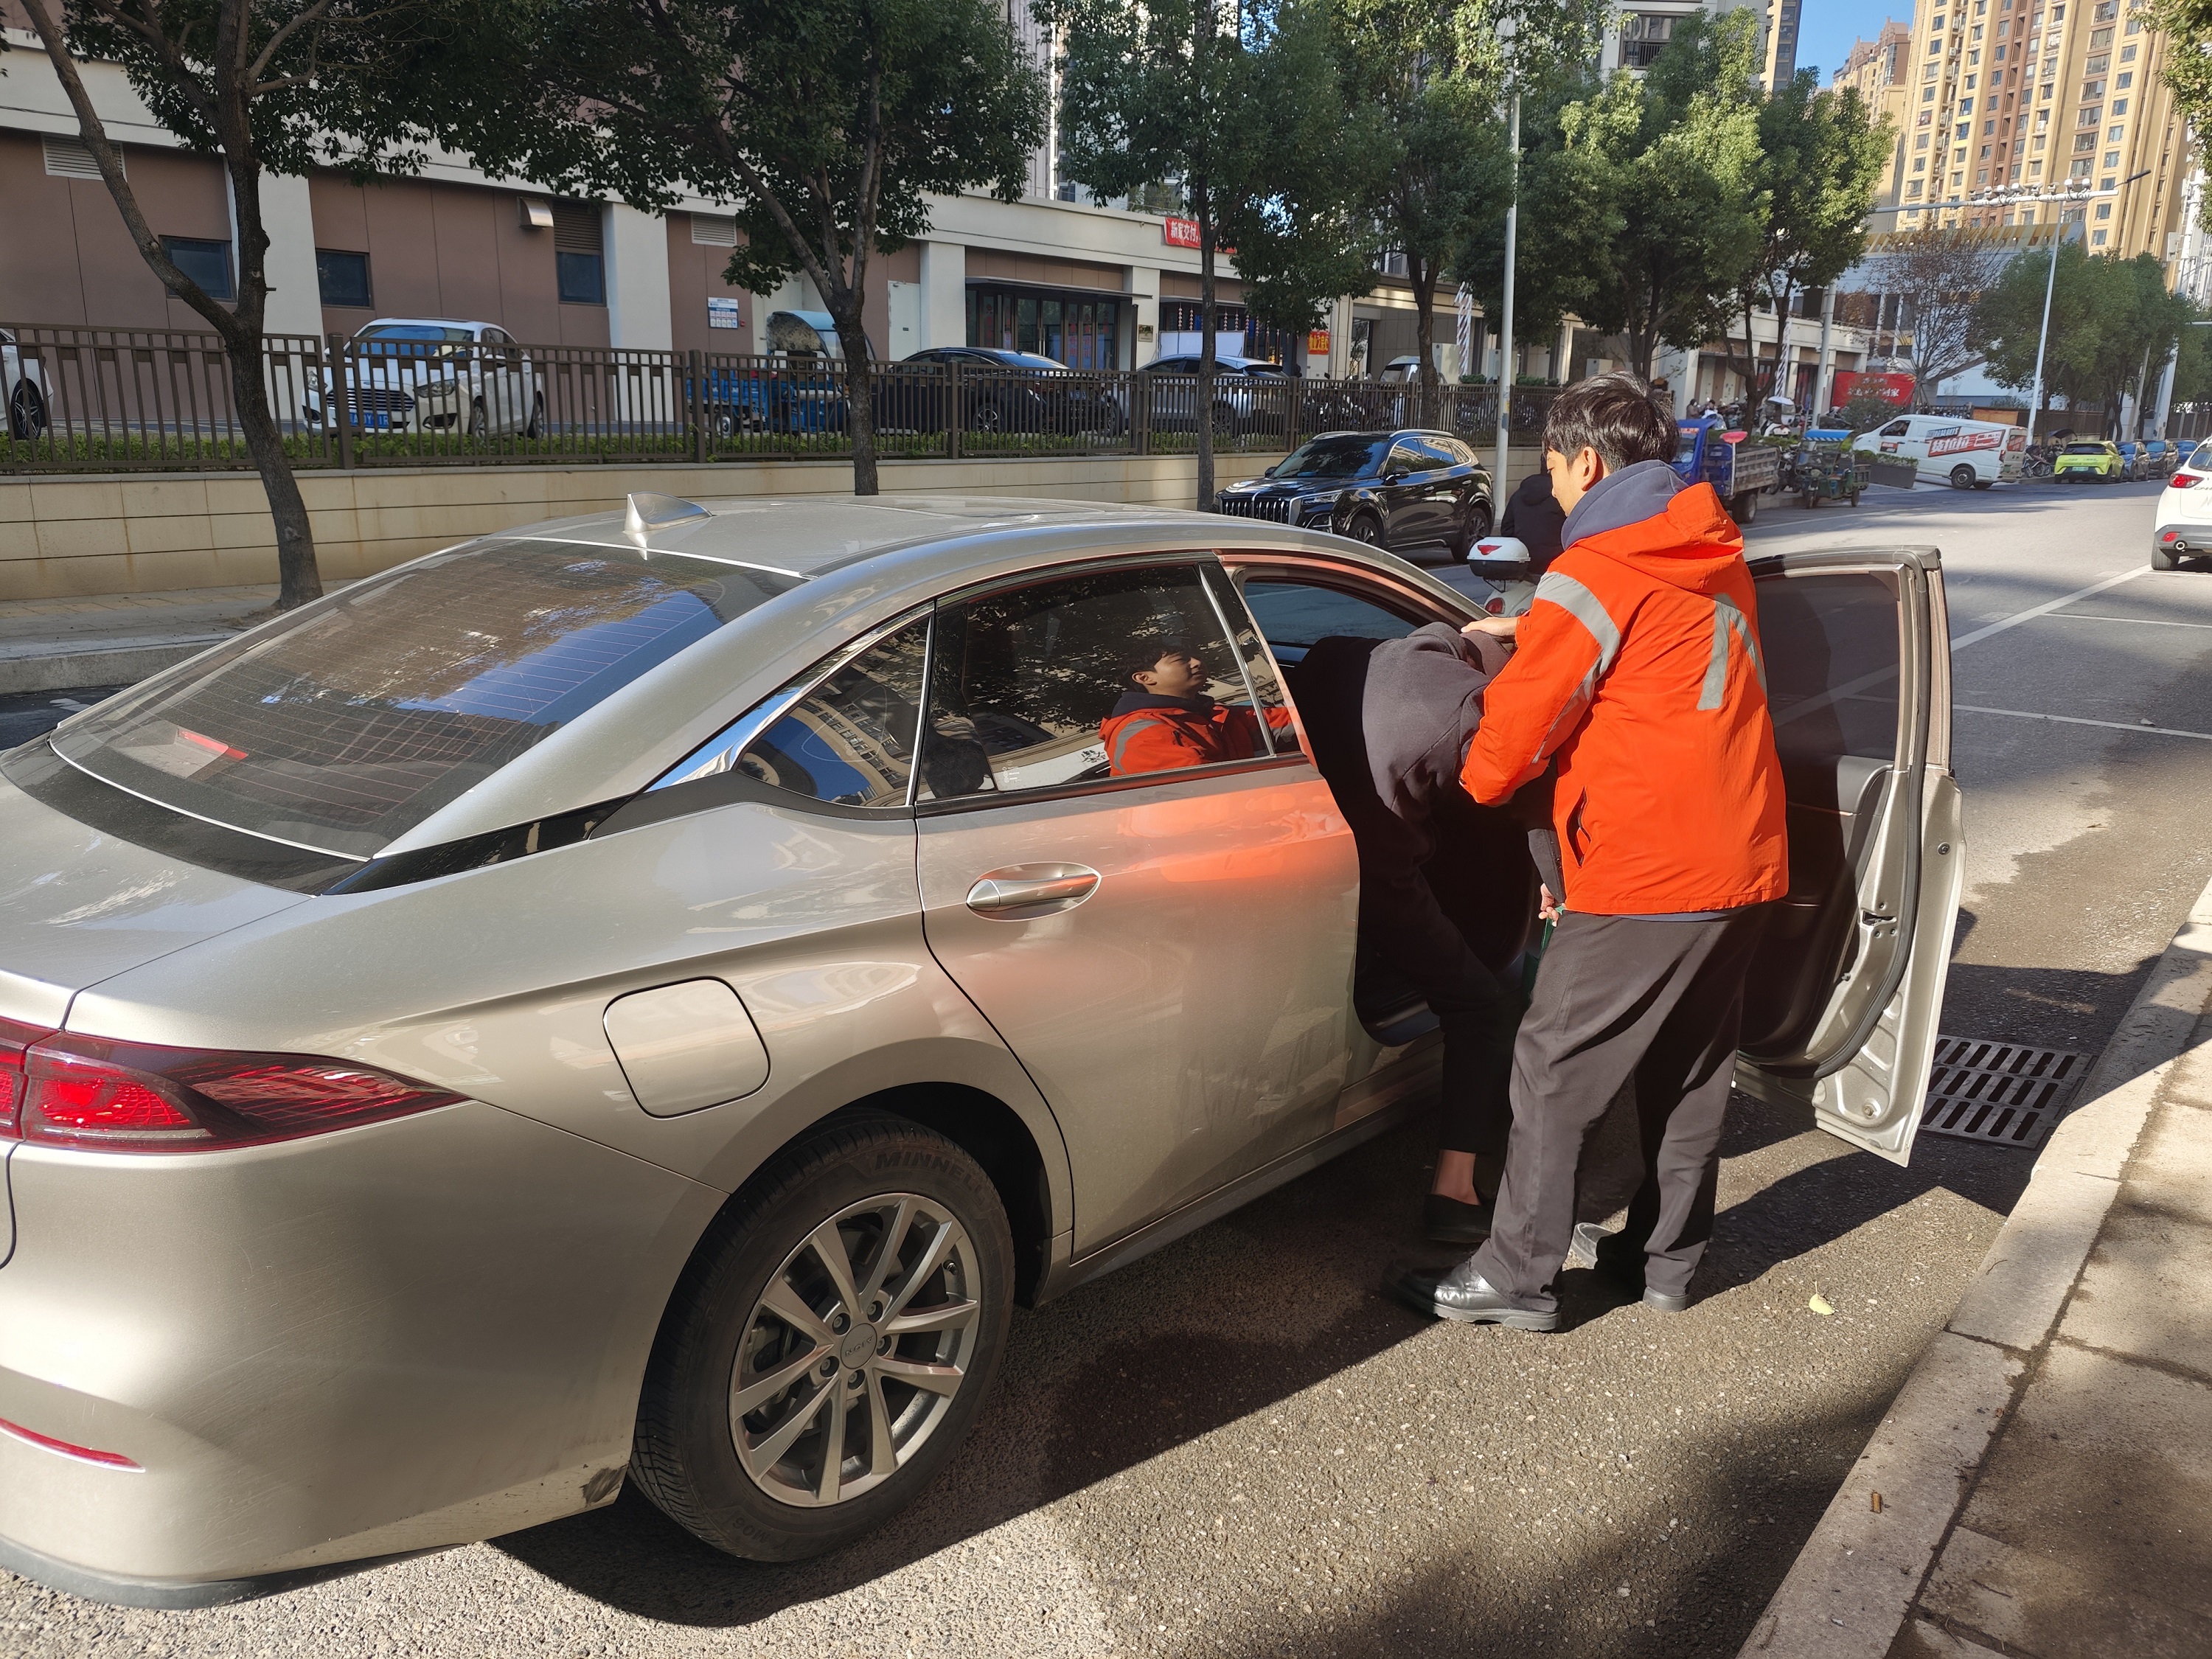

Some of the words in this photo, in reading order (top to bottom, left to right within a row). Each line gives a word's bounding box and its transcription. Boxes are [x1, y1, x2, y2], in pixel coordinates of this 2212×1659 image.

[1930, 436, 1969, 453] 货拉拉
[844, 1336, 875, 1357] AION
